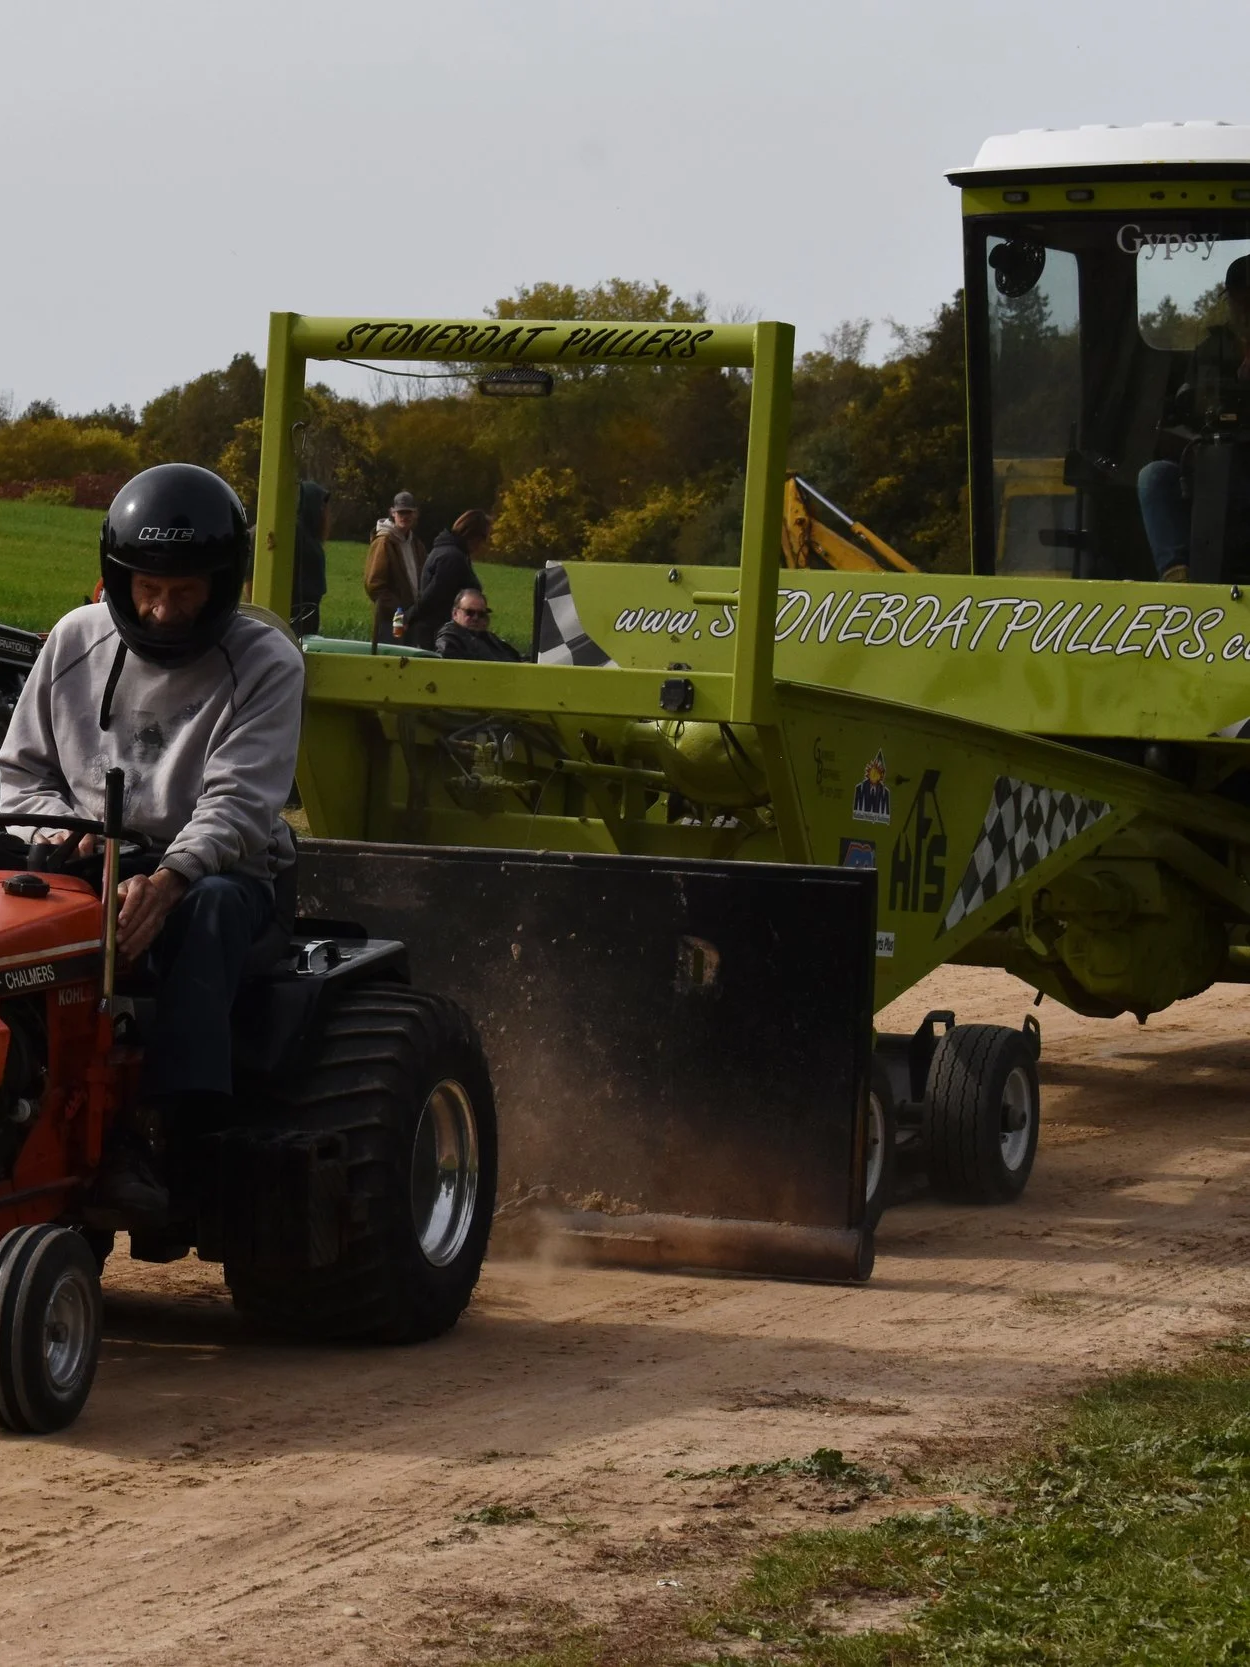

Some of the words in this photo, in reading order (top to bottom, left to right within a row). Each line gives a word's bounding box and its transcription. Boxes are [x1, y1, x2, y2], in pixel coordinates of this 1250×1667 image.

[1117, 224, 1219, 260] Gypsy
[337, 323, 555, 357] STONEBOAT
[558, 329, 714, 360] PULLERS
[138, 526, 195, 541] HJC
[5, 964, 56, 989] CHALMERS
